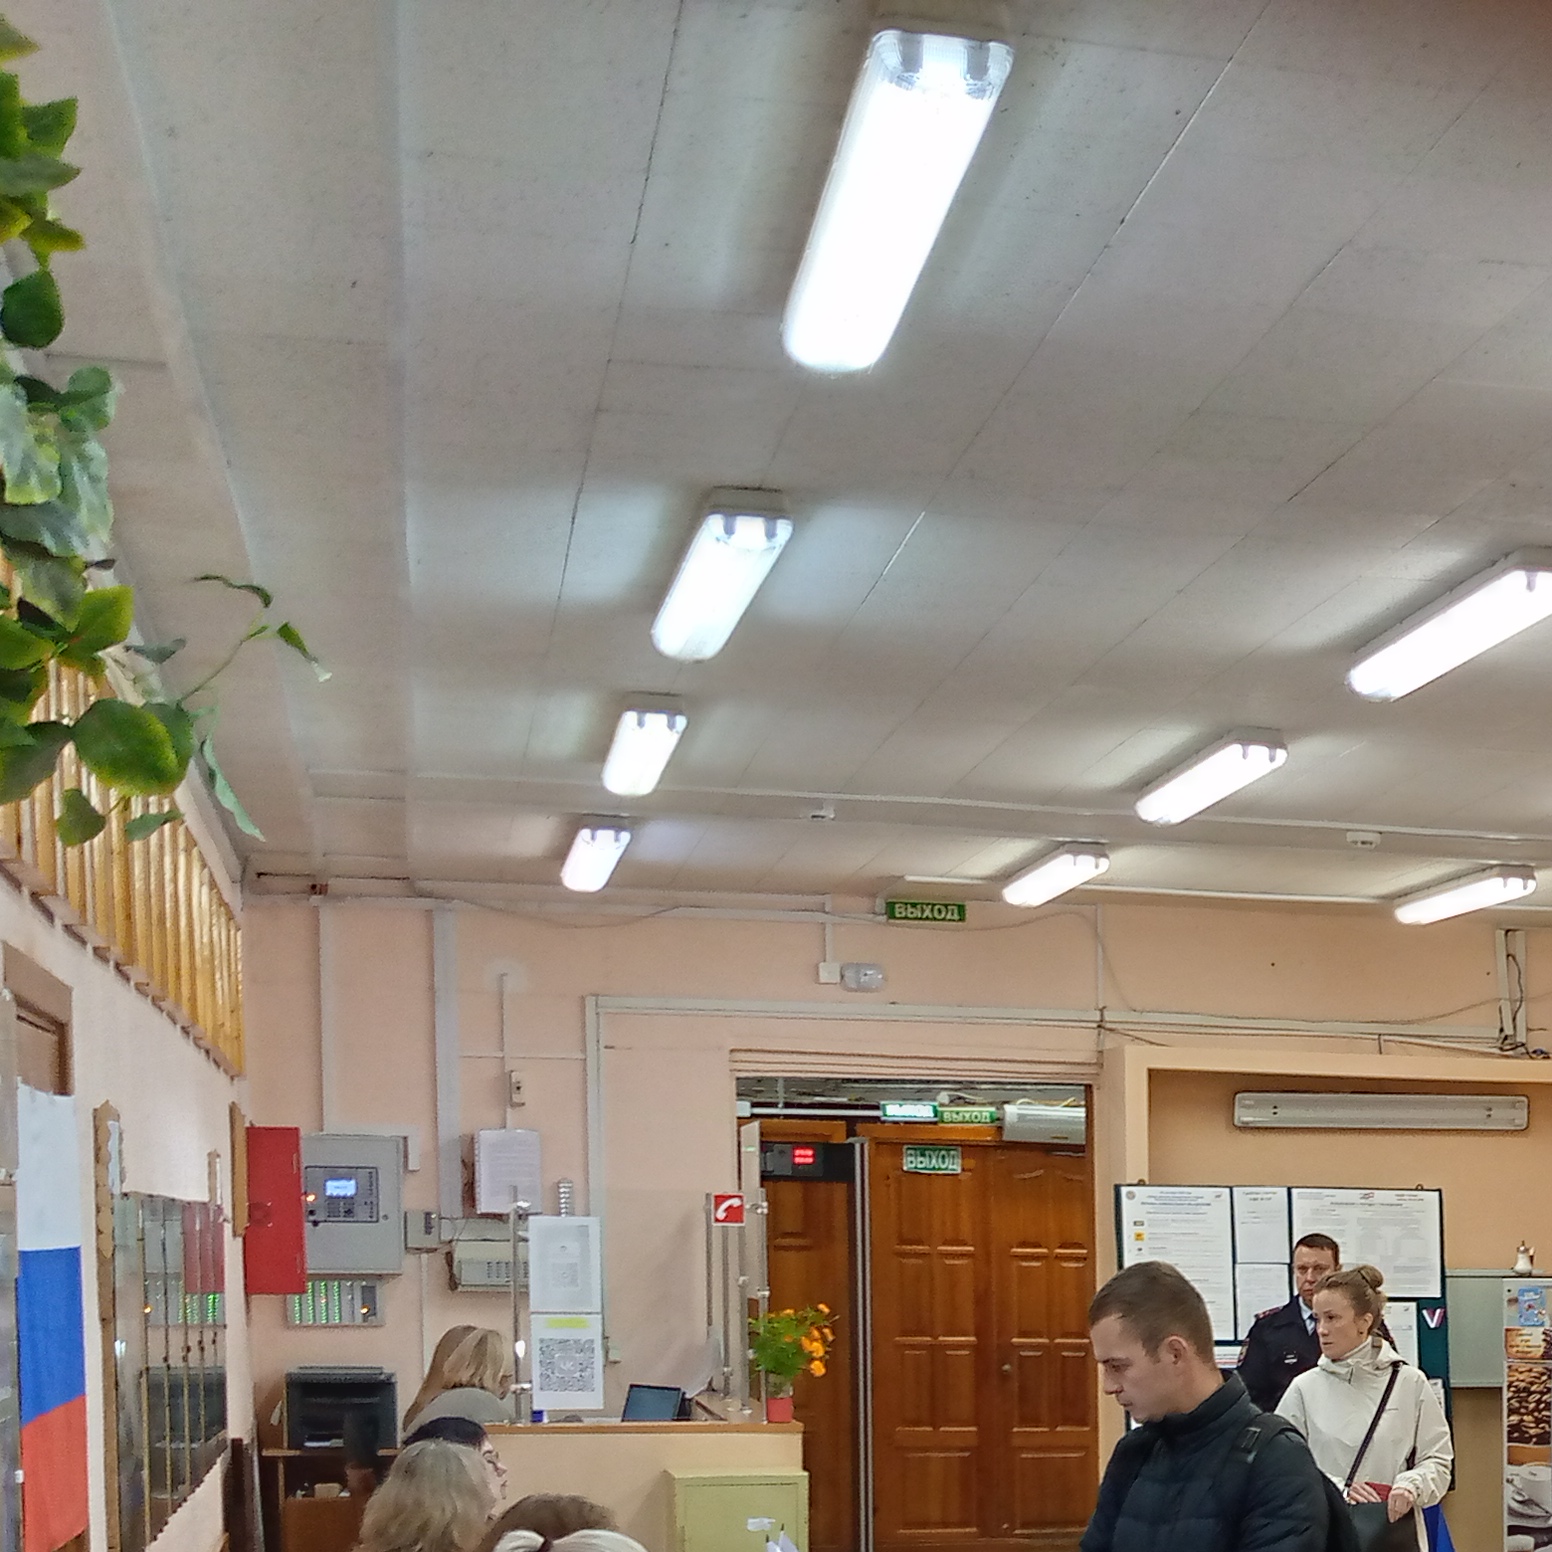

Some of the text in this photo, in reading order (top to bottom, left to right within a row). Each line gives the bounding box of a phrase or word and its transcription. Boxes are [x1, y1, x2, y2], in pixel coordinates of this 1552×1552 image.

[894, 903, 960, 921] ВЫХОД
[942, 1110, 991, 1123] ВЫХОД
[906, 1149, 959, 1170] ВЫХОД
